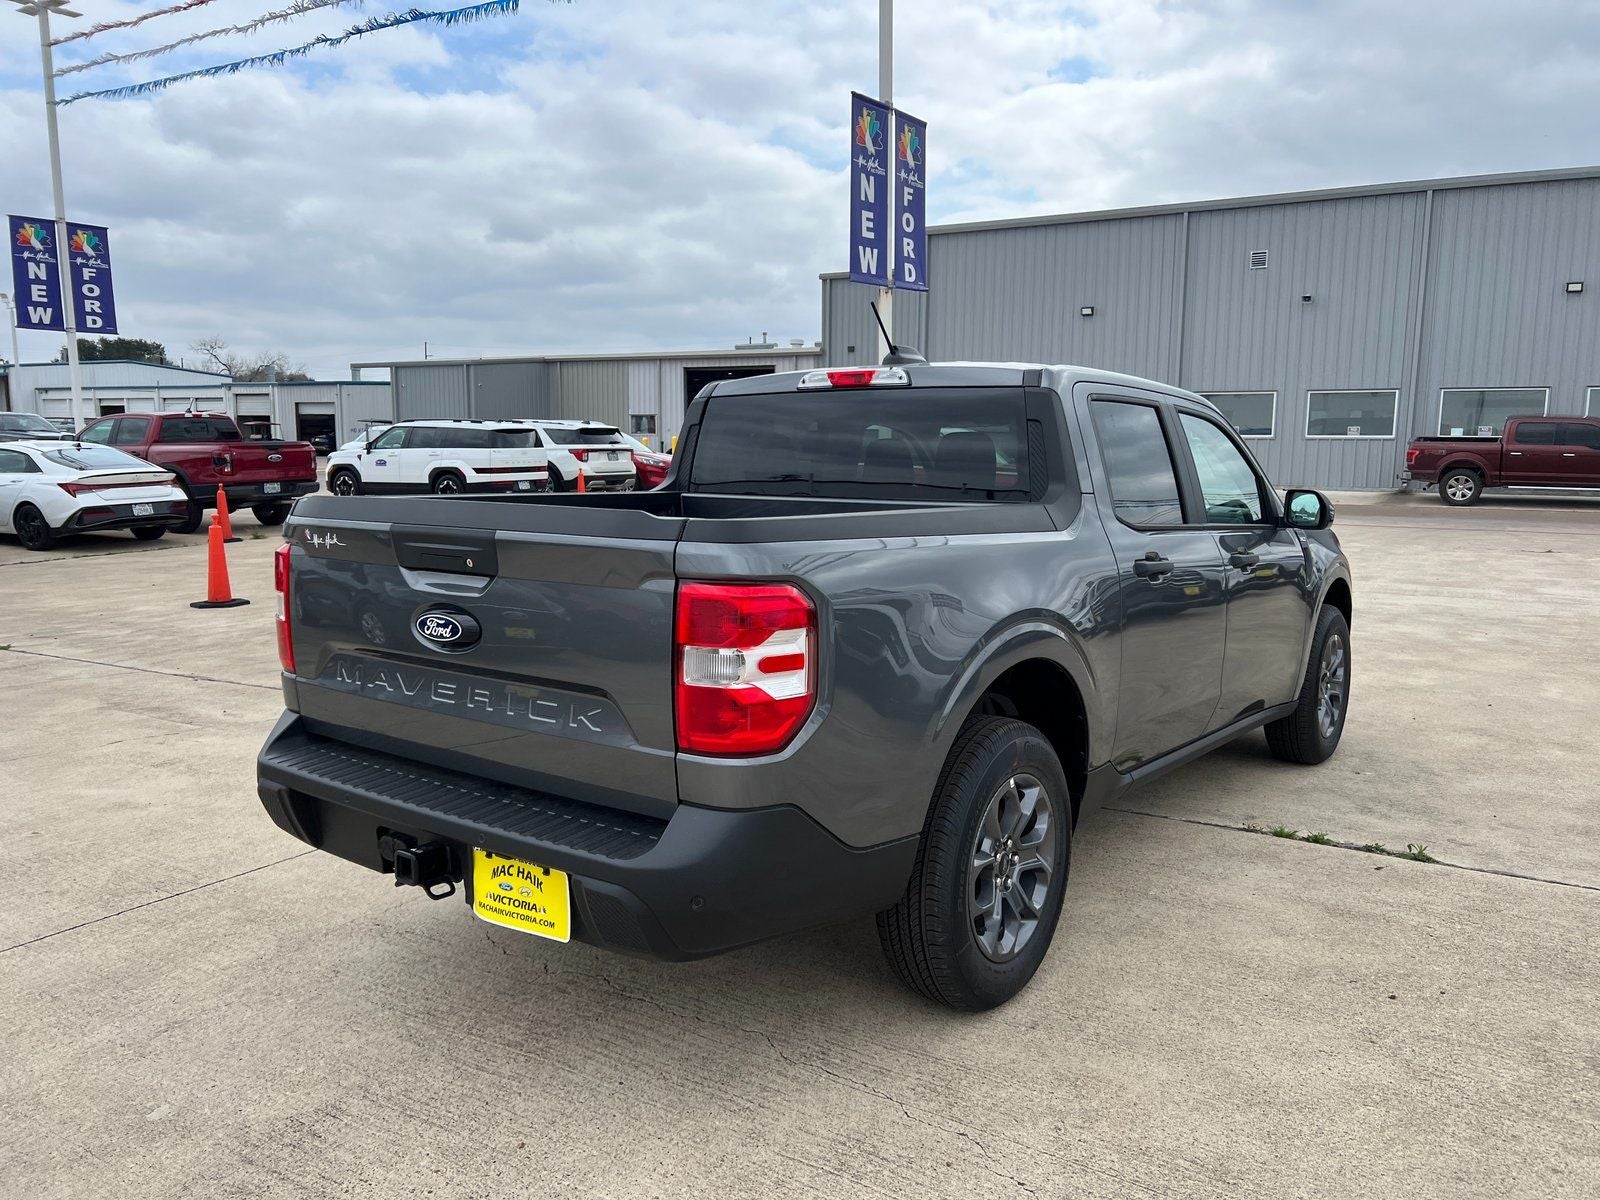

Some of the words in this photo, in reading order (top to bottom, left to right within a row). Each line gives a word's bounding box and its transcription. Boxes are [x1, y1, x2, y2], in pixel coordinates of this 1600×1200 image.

[858, 172, 878, 275] NEW
[901, 186, 916, 284] FORD
[27, 262, 53, 325] NEW
[81, 267, 103, 328] FORD
[424, 617, 453, 637] Ford
[336, 659, 602, 732] MAVERICK
[491, 864, 514, 879] MAC
[516, 866, 544, 893] HAIK
[492, 892, 538, 913] VICTORIA
